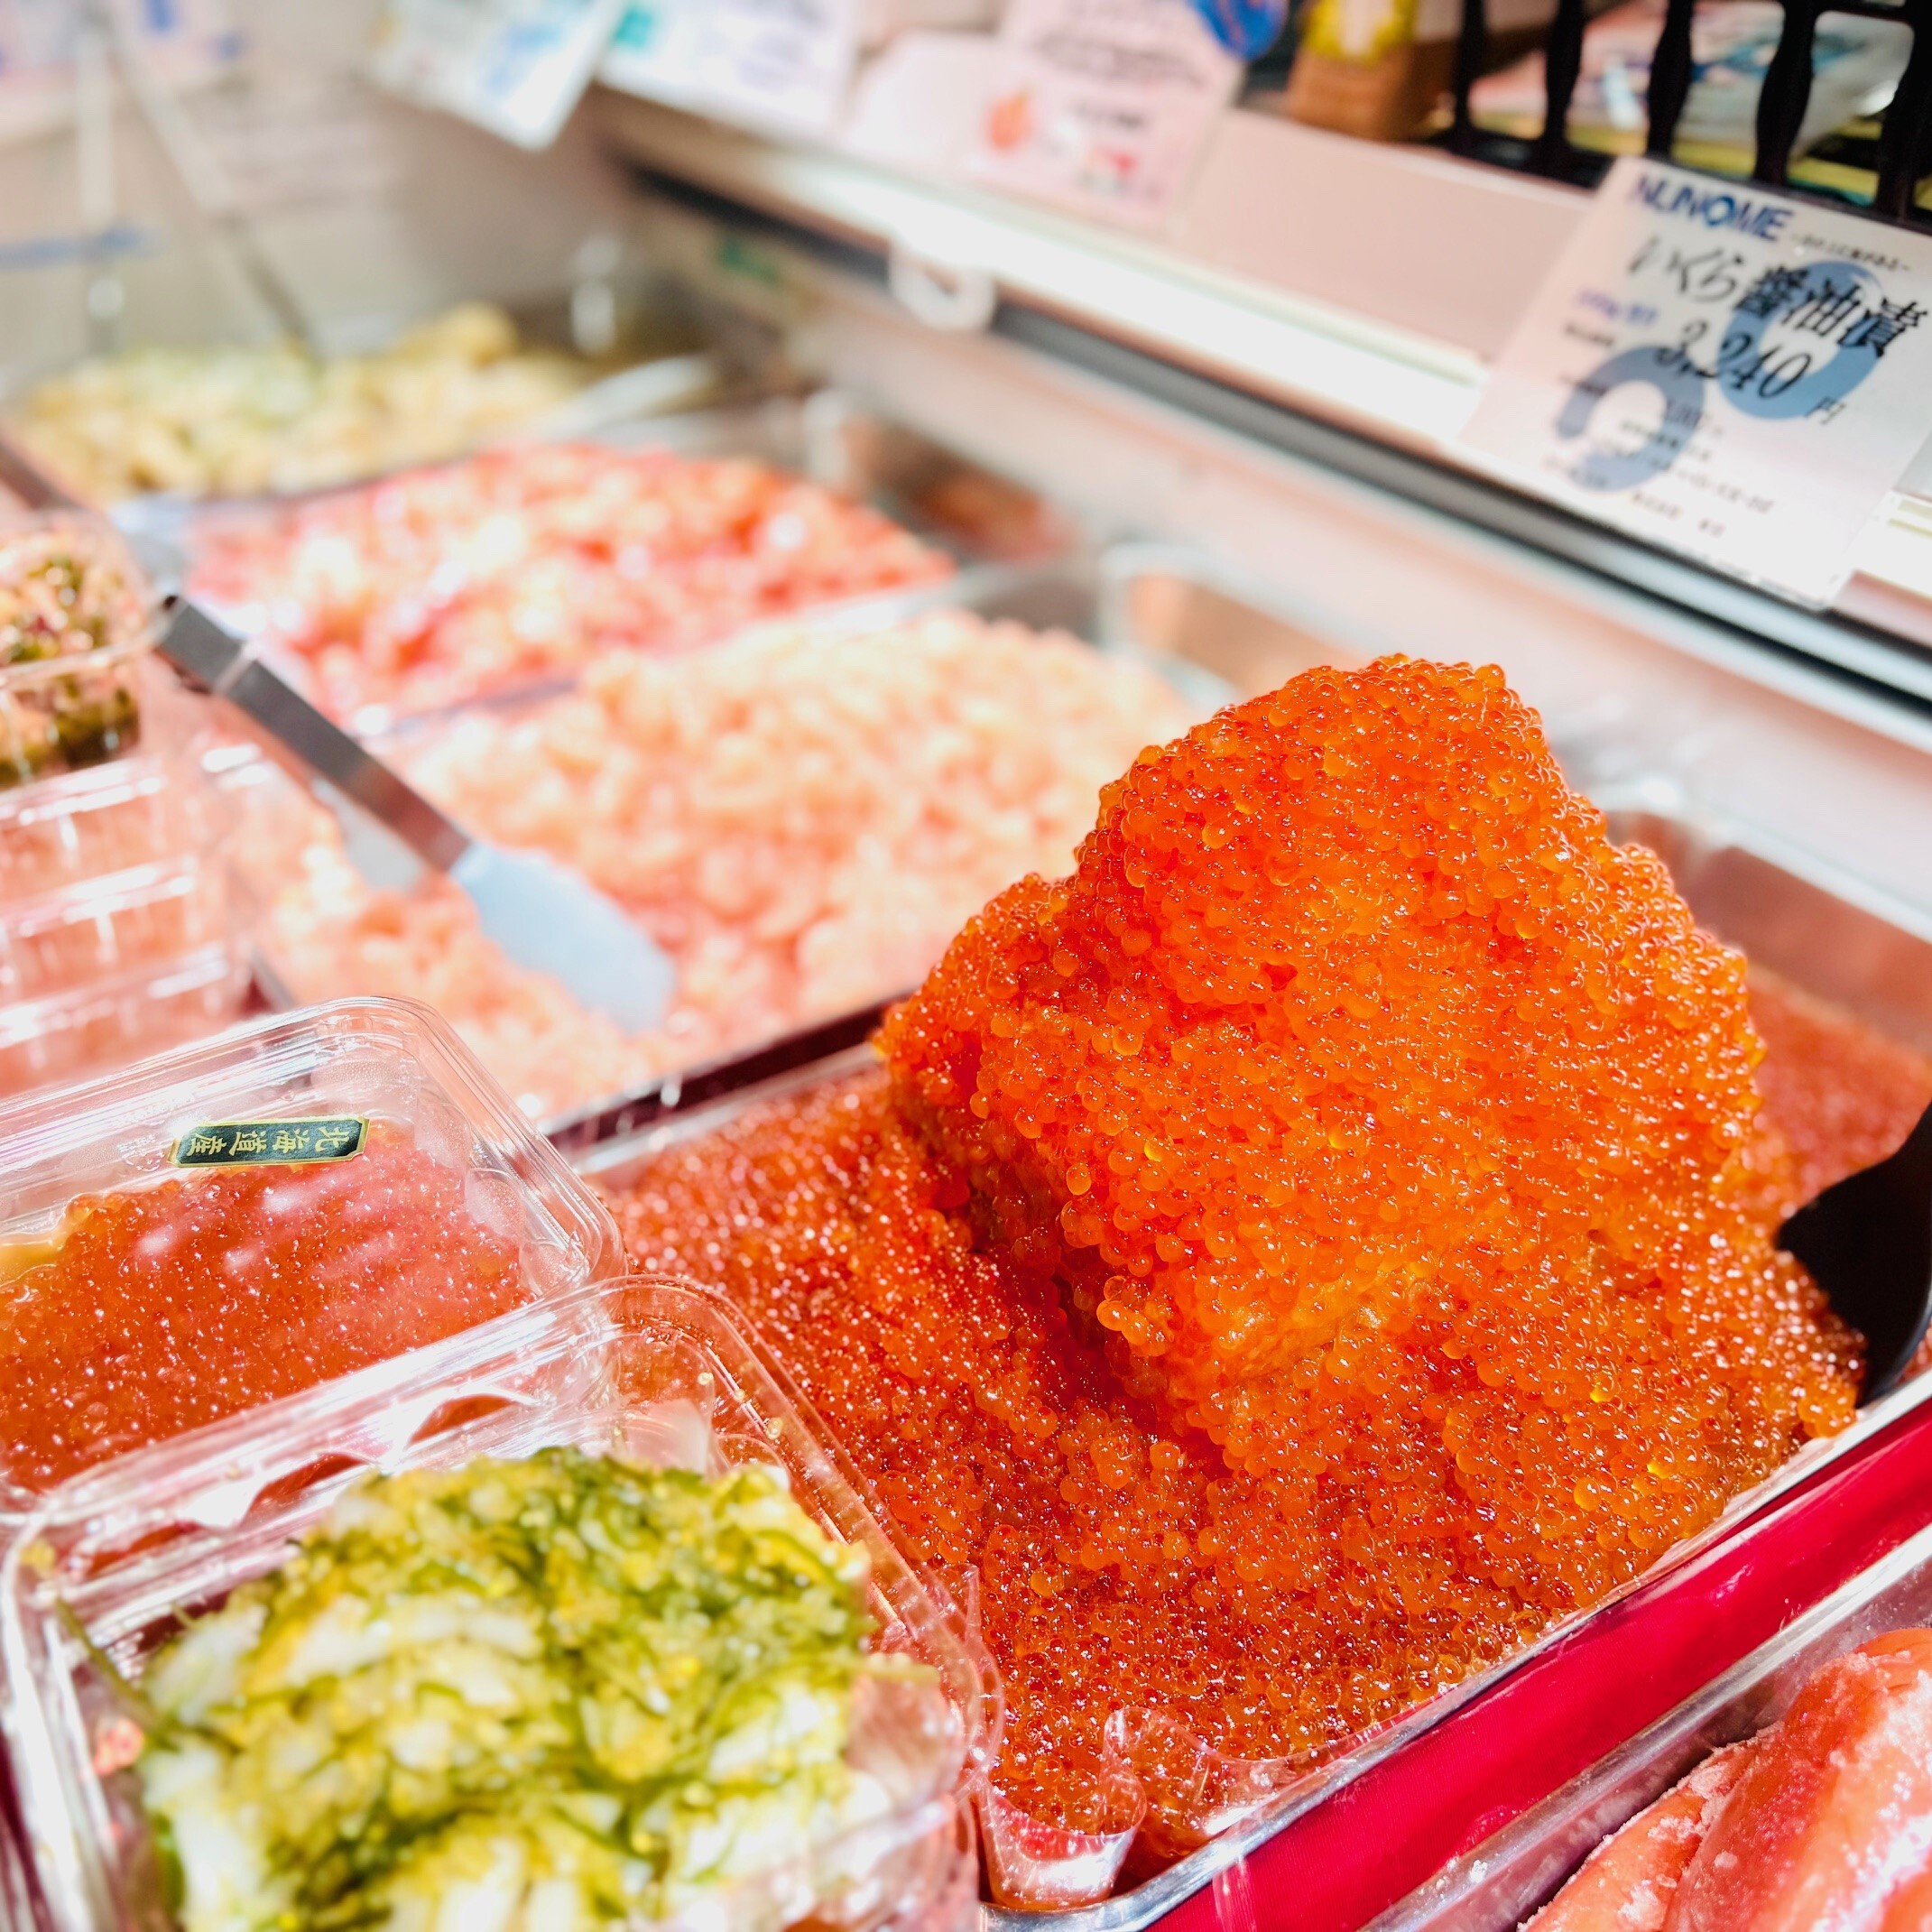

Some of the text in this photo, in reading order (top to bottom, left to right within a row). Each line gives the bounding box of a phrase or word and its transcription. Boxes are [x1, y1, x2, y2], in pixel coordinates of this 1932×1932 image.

[1631, 175, 1794, 242] NUNOME
[1654, 321, 1812, 399] 3,240
[187, 1126, 351, 1157] 北海道産
